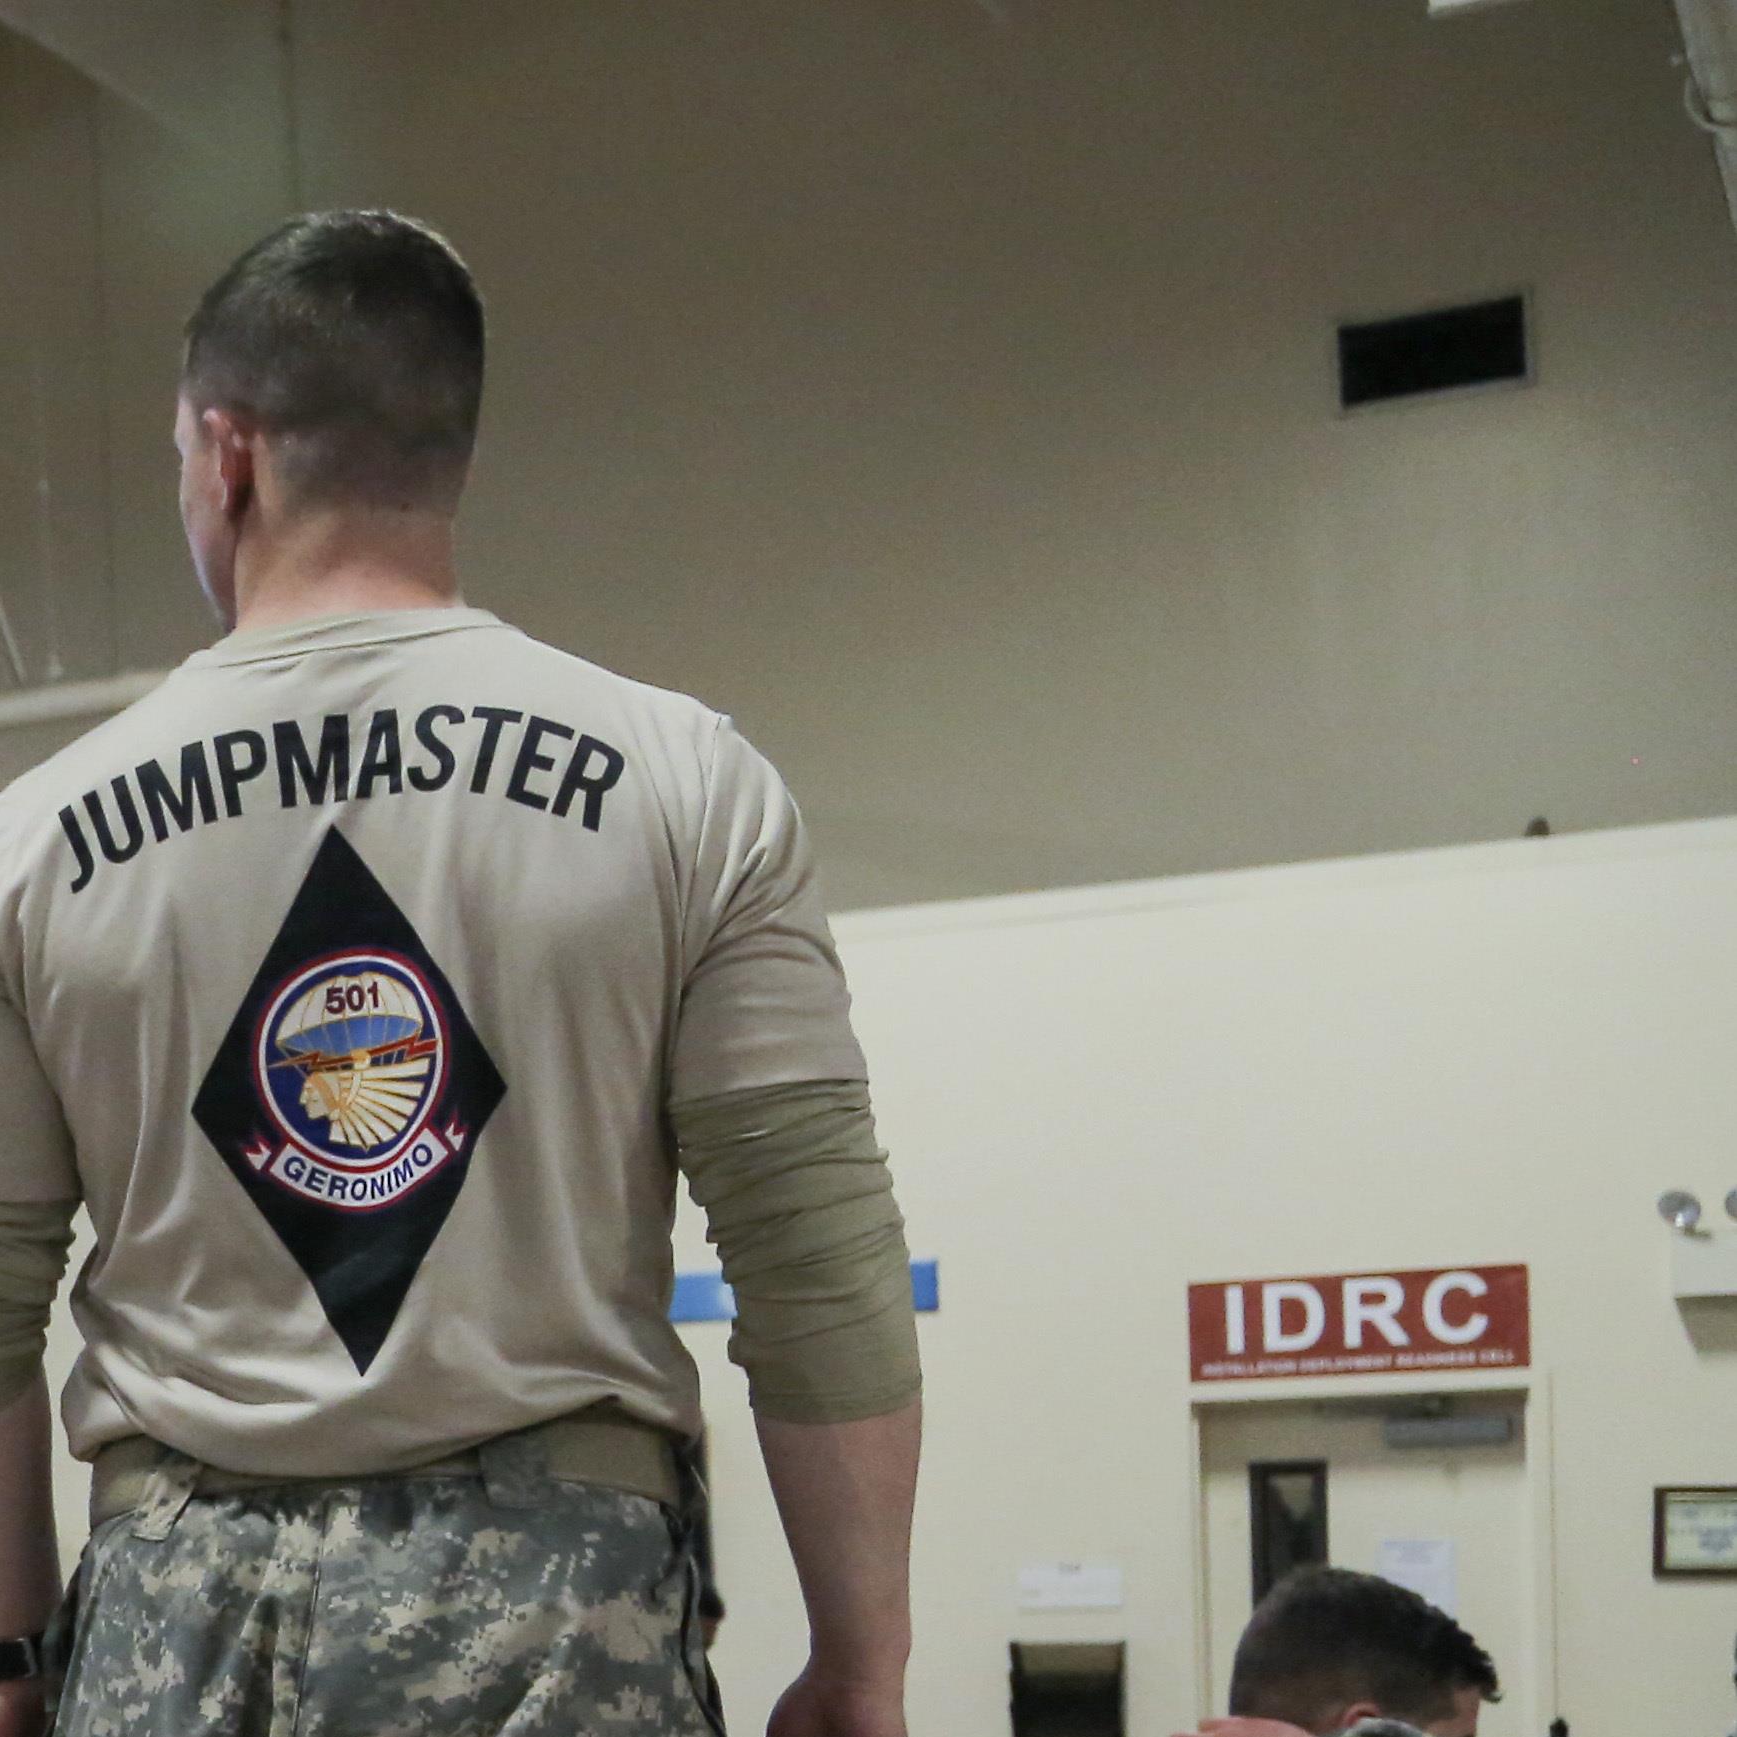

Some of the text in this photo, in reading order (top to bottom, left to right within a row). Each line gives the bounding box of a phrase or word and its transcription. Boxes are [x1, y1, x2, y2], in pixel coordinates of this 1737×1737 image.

[58, 704, 625, 893] JUMPMASTER
[325, 981, 380, 1015] 501
[283, 1143, 433, 1202] GERONIMO
[1225, 1270, 1489, 1355] IDRC
